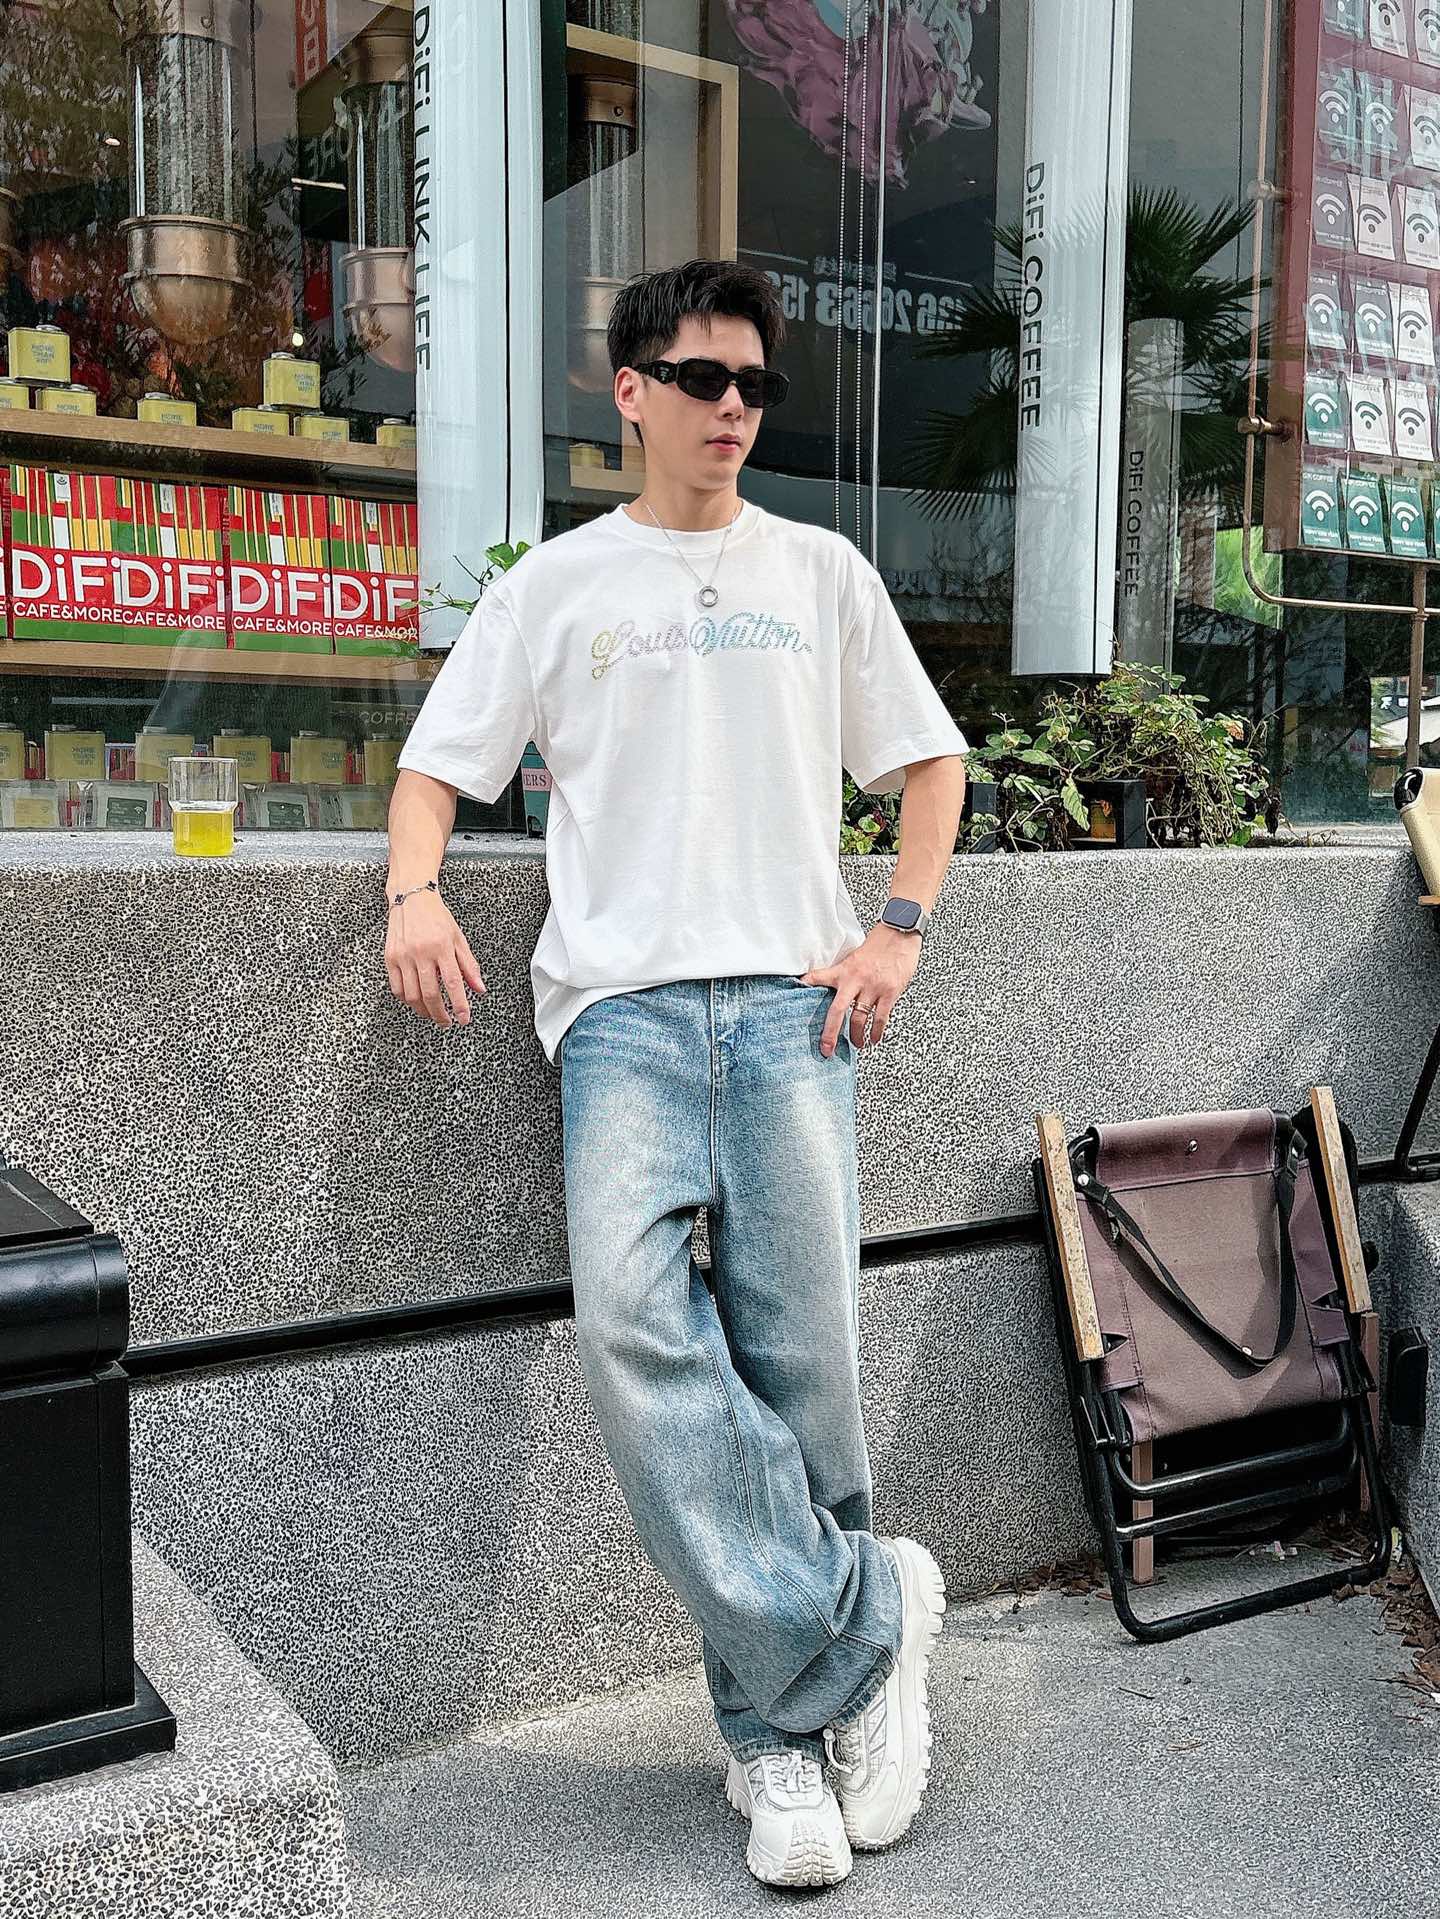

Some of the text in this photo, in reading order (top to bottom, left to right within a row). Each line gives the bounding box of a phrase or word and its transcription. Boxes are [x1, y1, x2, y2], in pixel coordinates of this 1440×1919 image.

[414, 5, 431, 372] DiFi LINK LIFE
[1020, 161, 1045, 432] DiFi COFFEE
[1125, 451, 1144, 598] DiFi COFFEE
[12, 549, 123, 605] DiFi
[121, 559, 225, 613] DiFi
[231, 565, 332, 619] DiFi
[333, 574, 415, 622] DiF
[13, 601, 123, 624] CAFE&MORE
[122, 610, 226, 631] CAFE&MORE
[233, 616, 333, 636] CAFE&MORE
[334, 622, 418, 640] CAFE&MOR
[591, 611, 814, 681] Louis Vuitton
